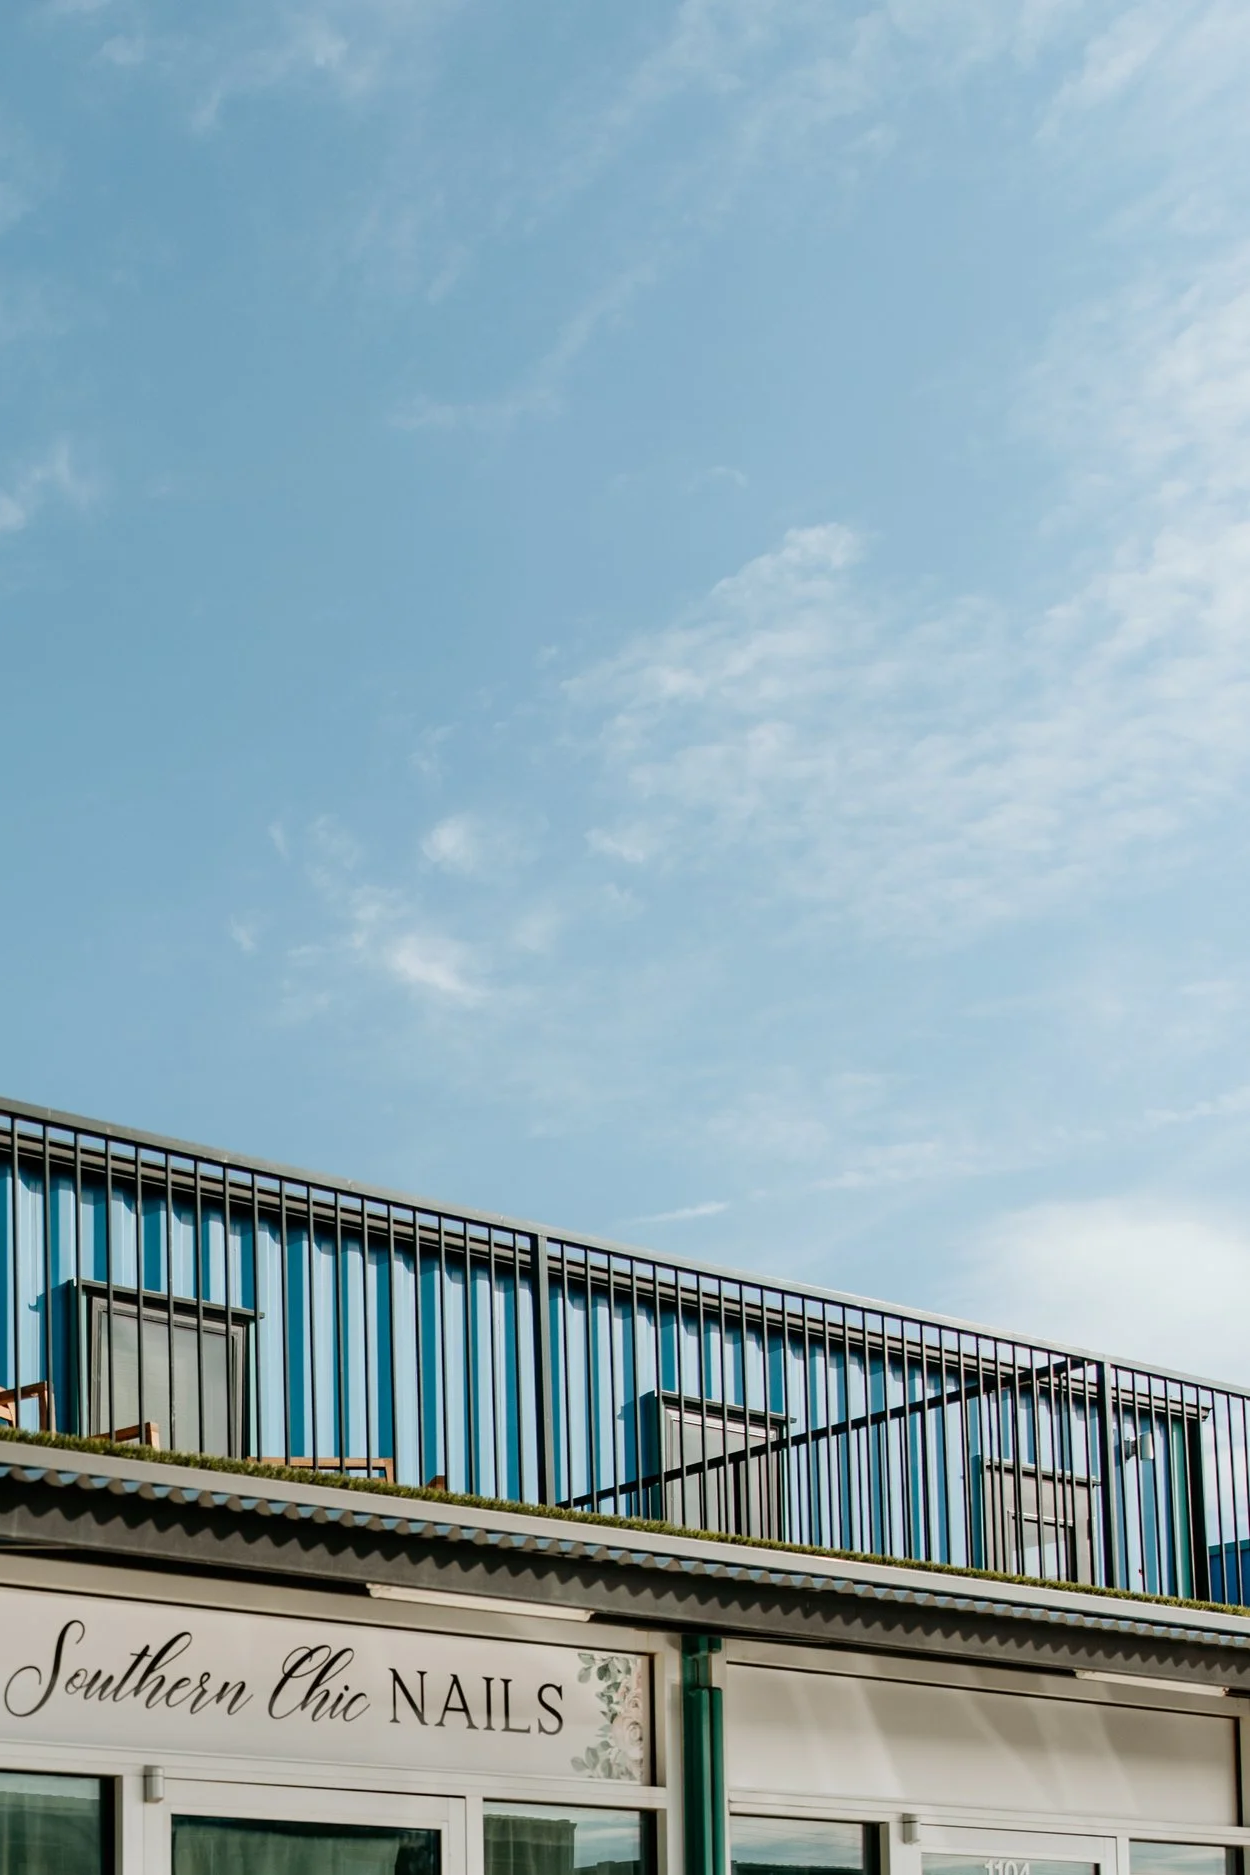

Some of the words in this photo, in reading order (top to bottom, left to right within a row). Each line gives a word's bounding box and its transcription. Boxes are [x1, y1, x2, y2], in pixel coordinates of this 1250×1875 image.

[4, 1619, 253, 1717] Southern
[268, 1644, 370, 1723] Chic
[389, 1668, 565, 1736] NAILS
